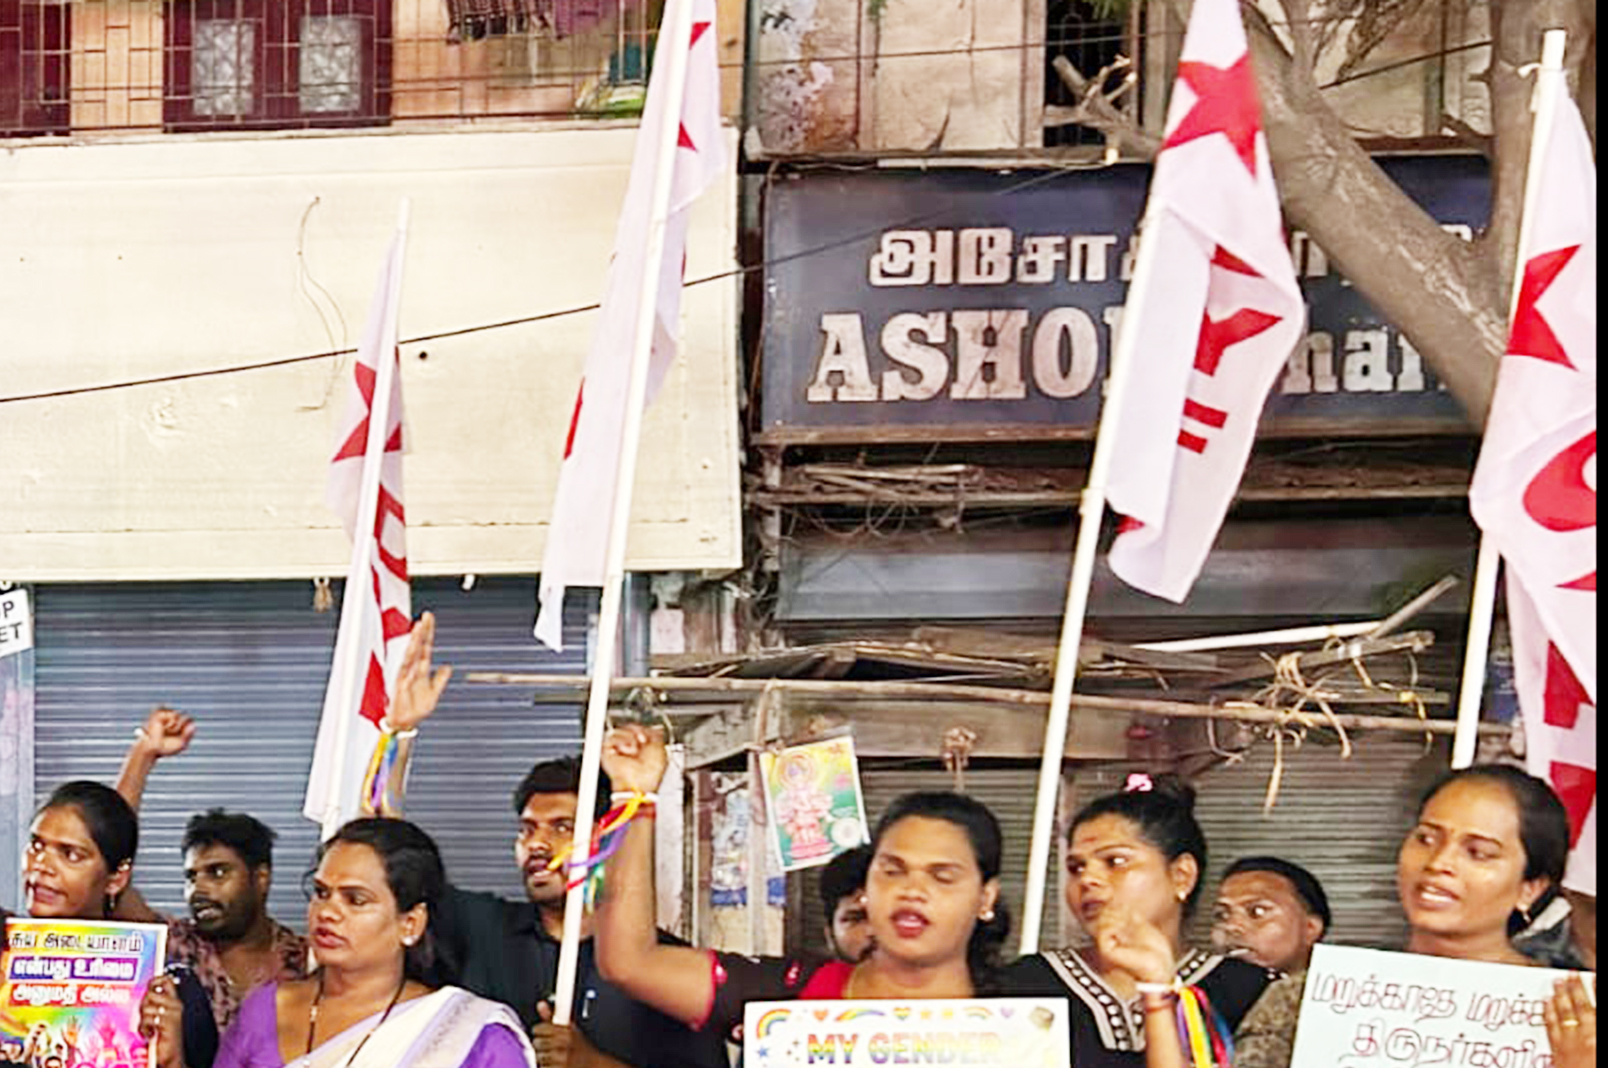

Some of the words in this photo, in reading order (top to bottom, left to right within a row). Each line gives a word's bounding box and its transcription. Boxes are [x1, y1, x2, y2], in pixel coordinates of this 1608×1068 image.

[869, 226, 1141, 286] அசோ
[806, 306, 1112, 402] ASHO
[806, 1033, 859, 1065] MY
[868, 1032, 1000, 1065] GENDER
